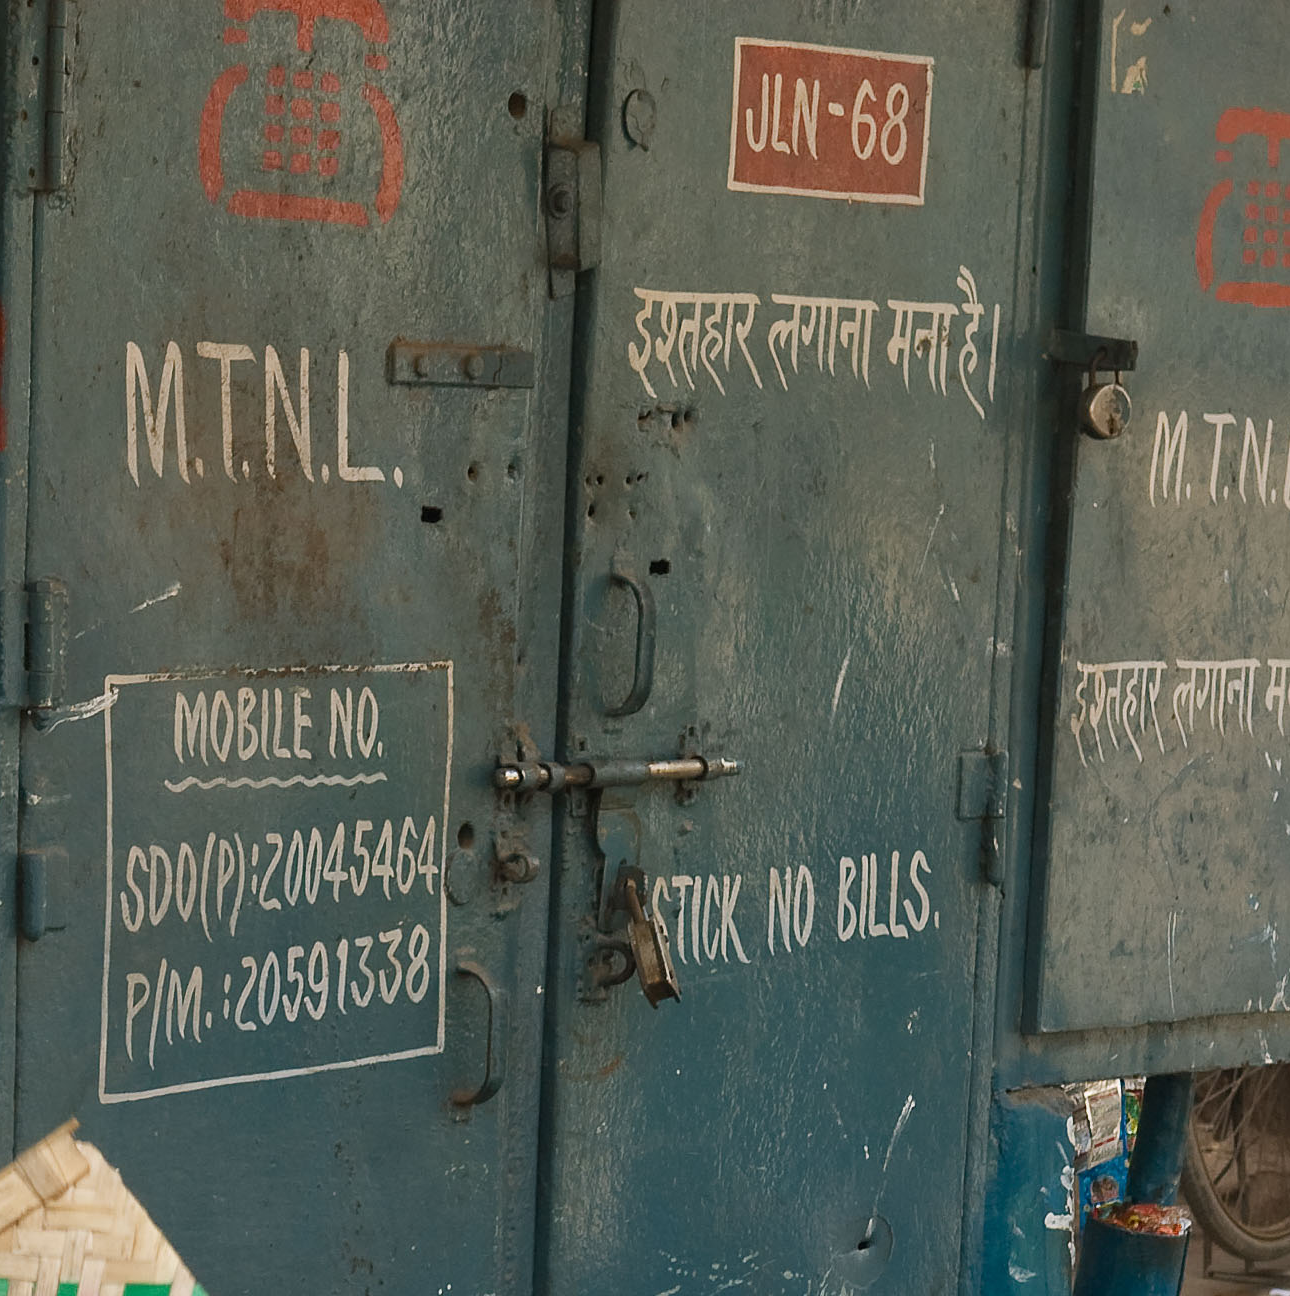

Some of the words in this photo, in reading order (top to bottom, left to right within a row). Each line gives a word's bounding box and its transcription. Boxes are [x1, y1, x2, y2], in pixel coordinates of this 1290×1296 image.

[745, 73, 910, 165] JLN-68
[628, 287, 763, 399] इश्तहार
[767, 293, 880, 392] लगाना
[887, 299, 960, 397] मना
[125, 340, 404, 488] M.T.N.L.
[173, 685, 314, 767] MOBILE
[327, 684, 384, 760] NO.
[1173, 657, 1261, 749] लगाना
[651, 873, 752, 966] STICK
[767, 864, 816, 957] NO
[836, 849, 941, 943] BILLS.
